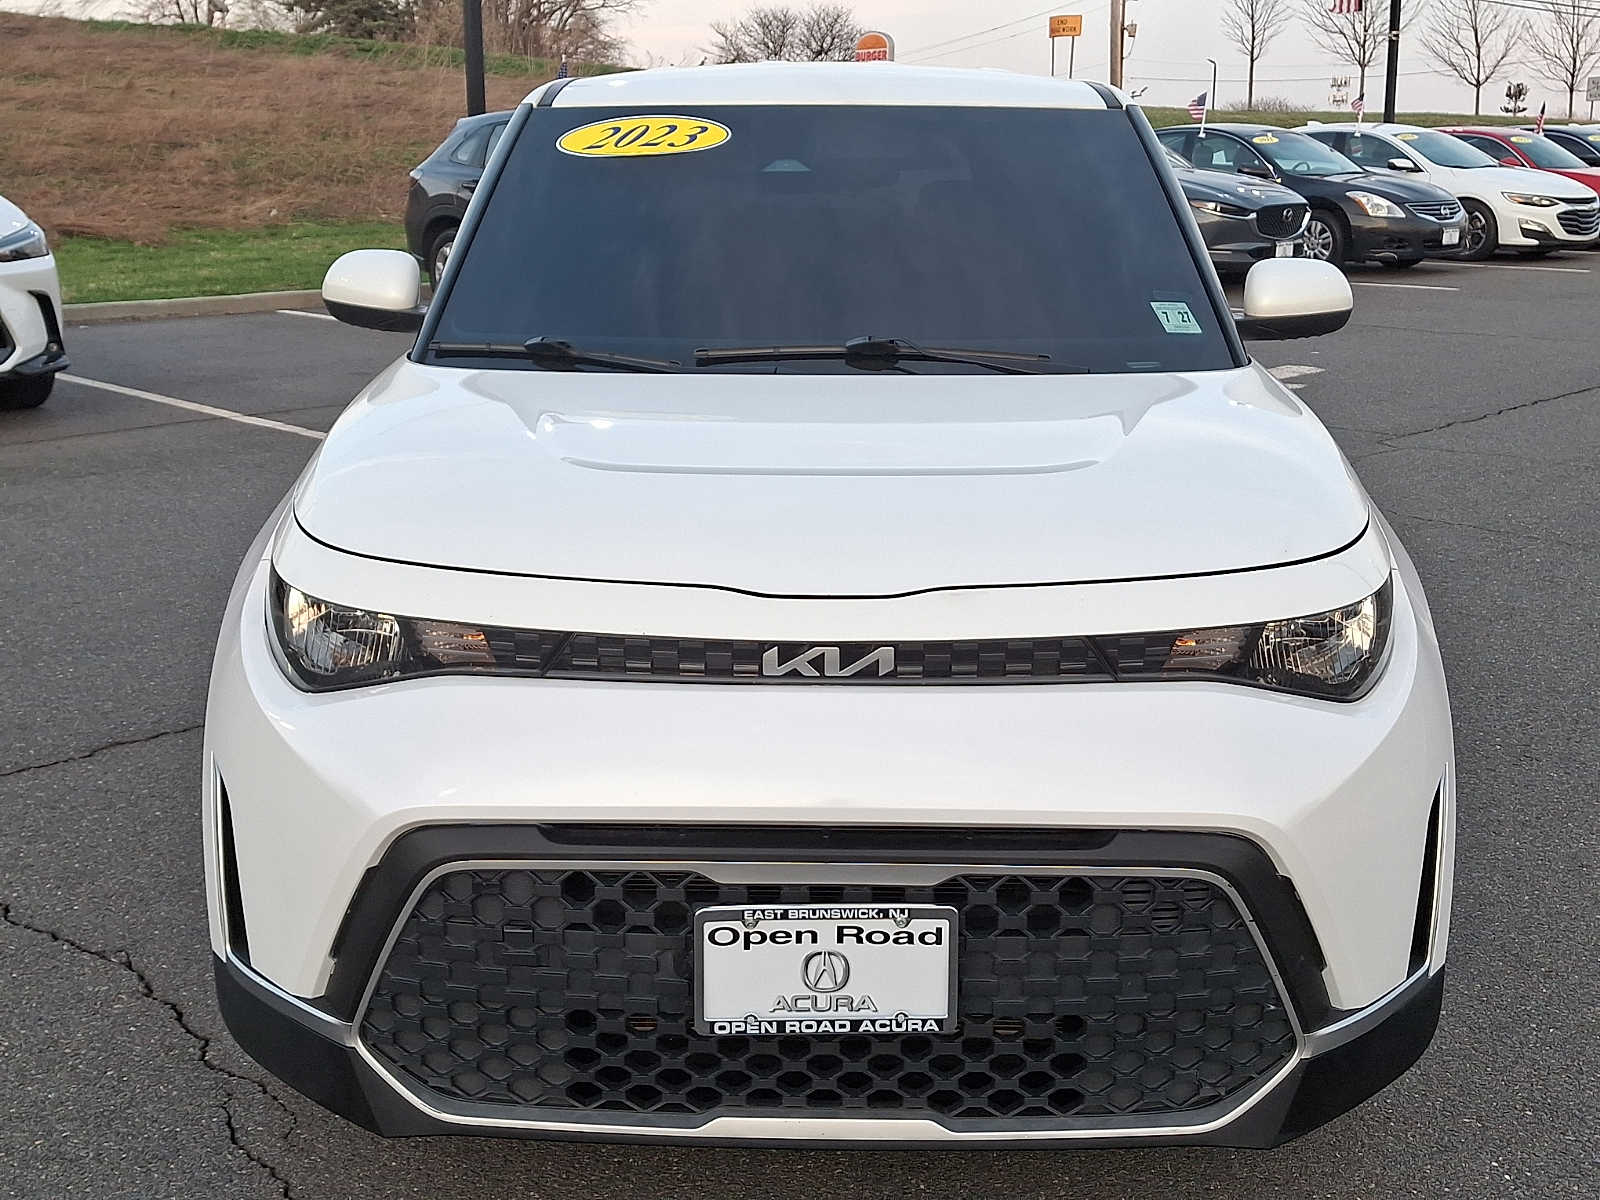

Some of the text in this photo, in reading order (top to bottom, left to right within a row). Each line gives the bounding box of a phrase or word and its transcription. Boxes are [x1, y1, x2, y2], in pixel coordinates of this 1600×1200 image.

[855, 50, 887, 61] BURGER
[582, 125, 709, 150] 2023
[762, 646, 895, 677] KIA
[743, 908, 909, 920] EAST BRUNSWICK, NJ
[707, 925, 943, 951] Open Road
[768, 994, 878, 1013] ACURA
[713, 1019, 940, 1035] OPEN ROAD ACURA
